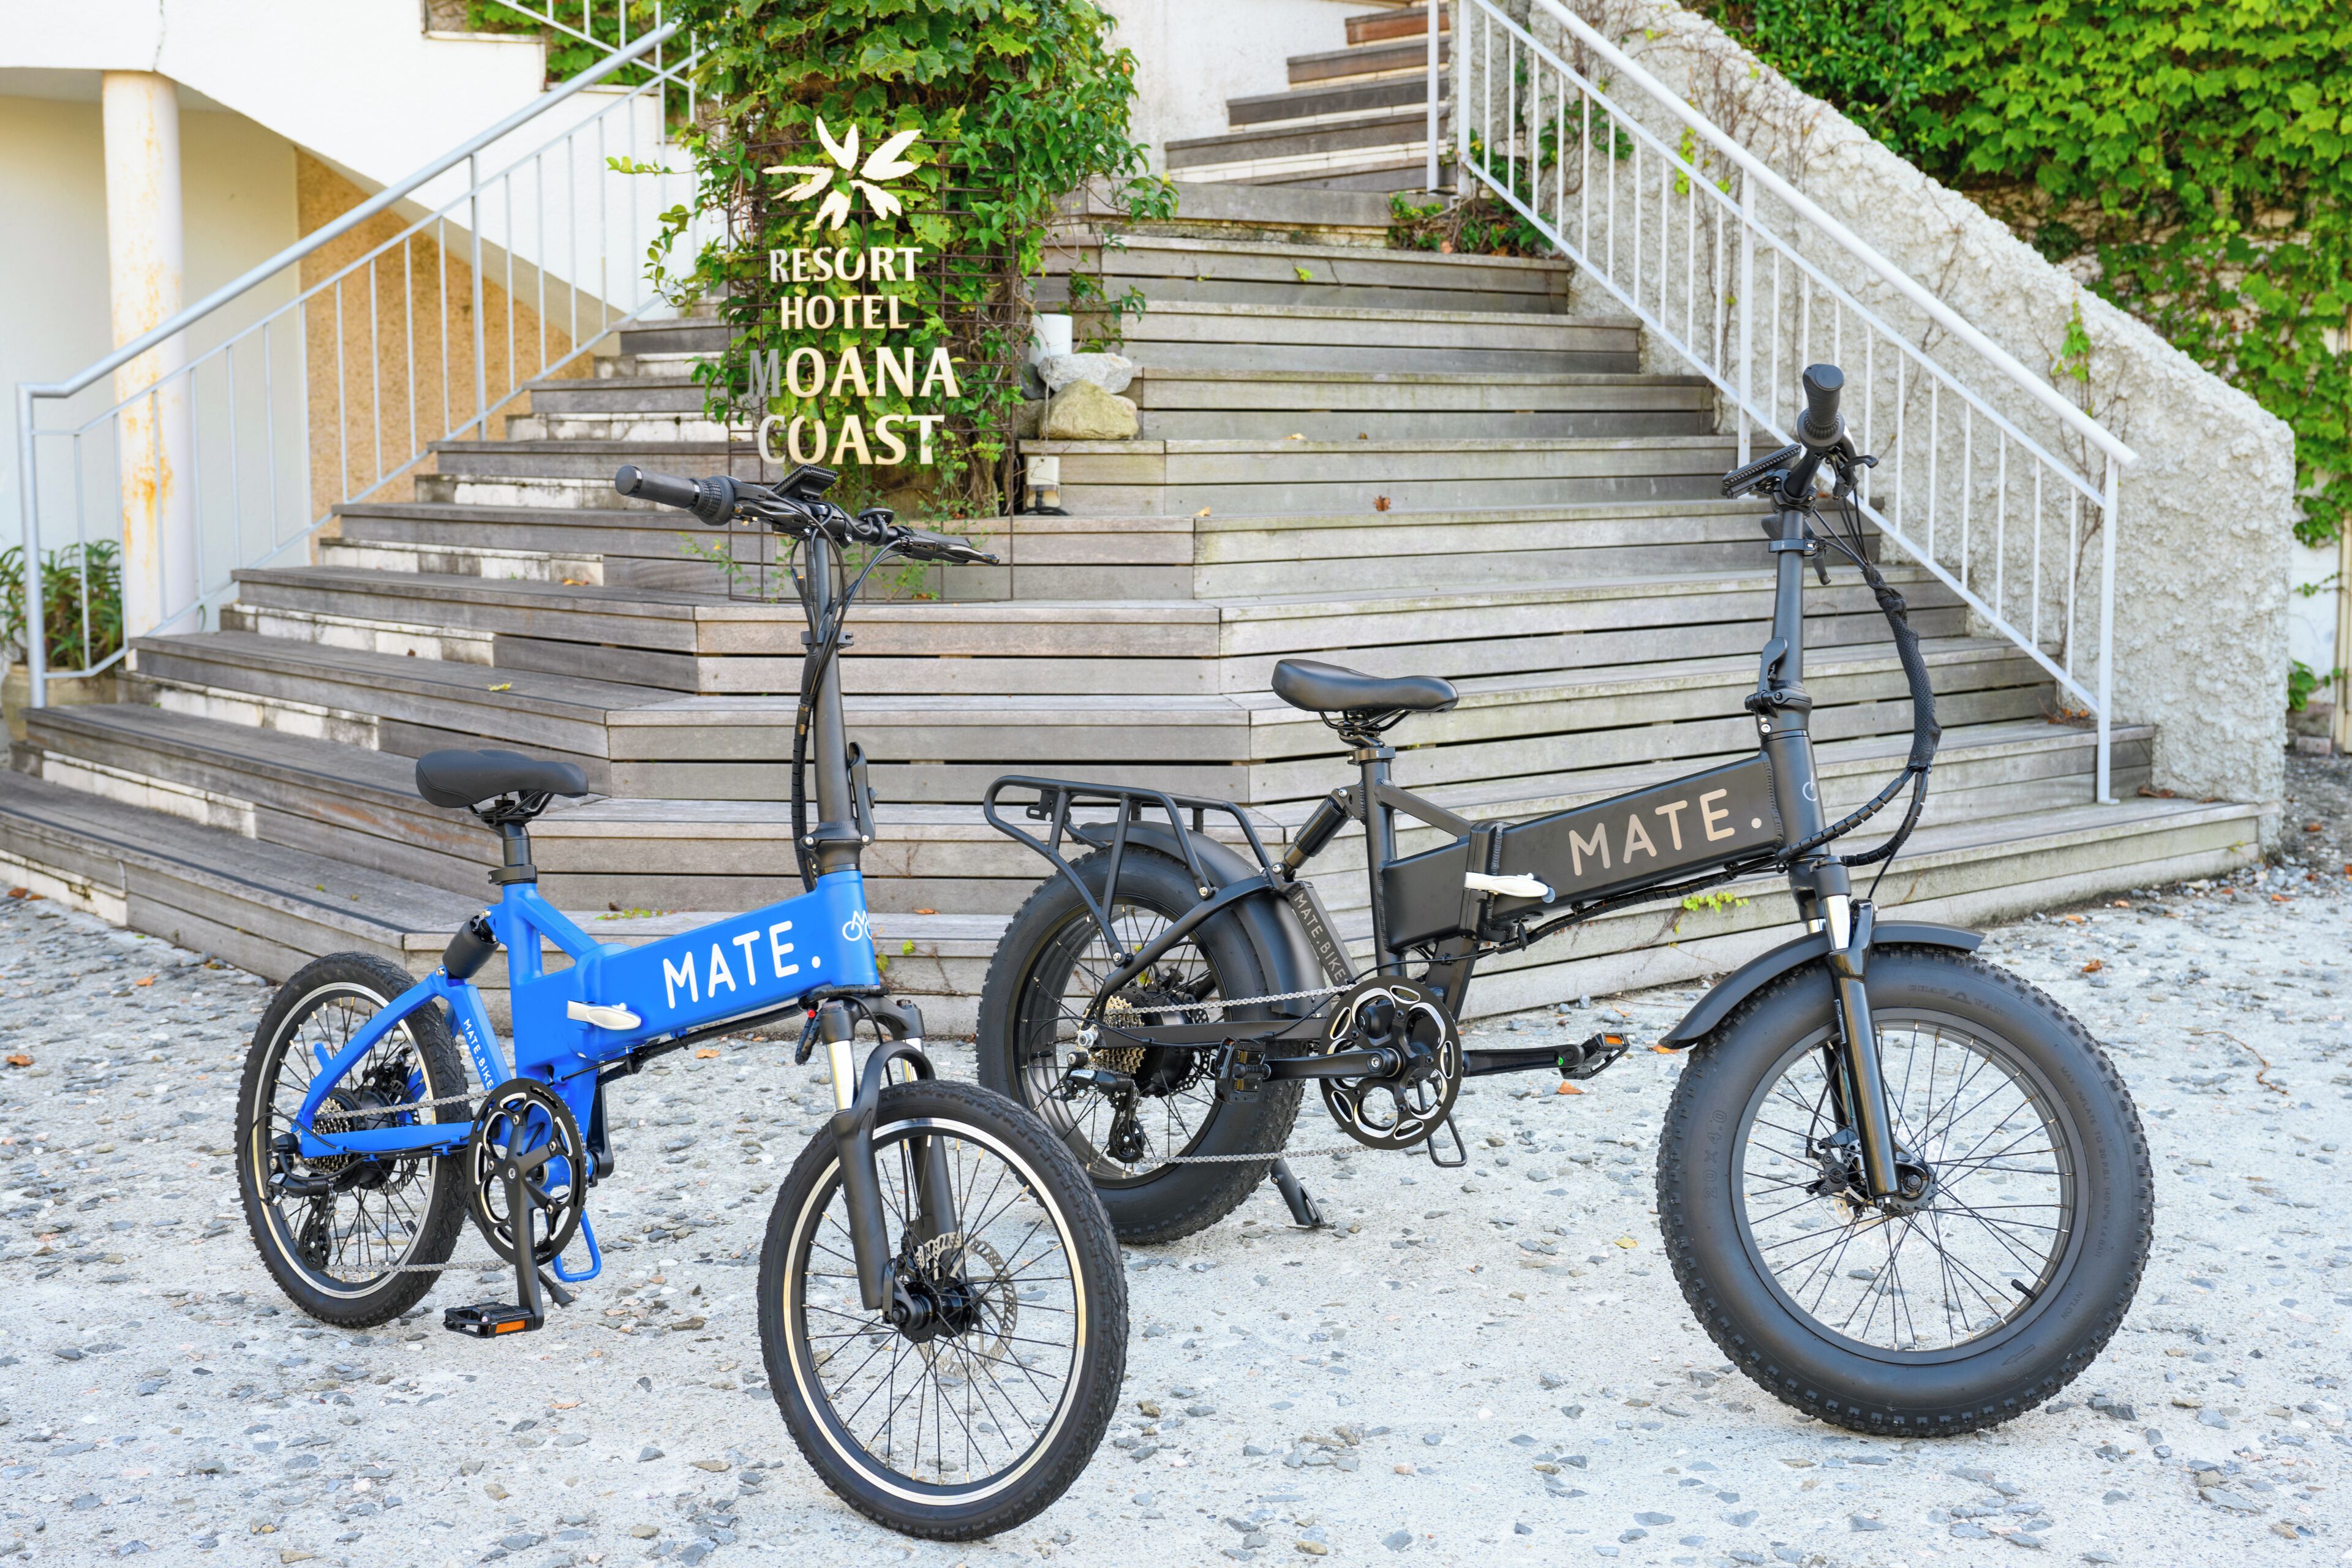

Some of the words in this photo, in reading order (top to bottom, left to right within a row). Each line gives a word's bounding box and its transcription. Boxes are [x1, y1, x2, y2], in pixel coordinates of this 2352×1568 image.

[769, 246, 923, 284] RESORT
[780, 295, 910, 331] HOTEL
[747, 347, 961, 399] MOANA
[757, 414, 945, 466] COAST
[1569, 788, 1763, 876] MATE.
[1294, 893, 1346, 981] MATE.BIKE
[663, 921, 821, 1009] MATE.
[463, 1019, 494, 1089] MATE.BIKE
[2060, 1292, 2083, 1319] NYLON
